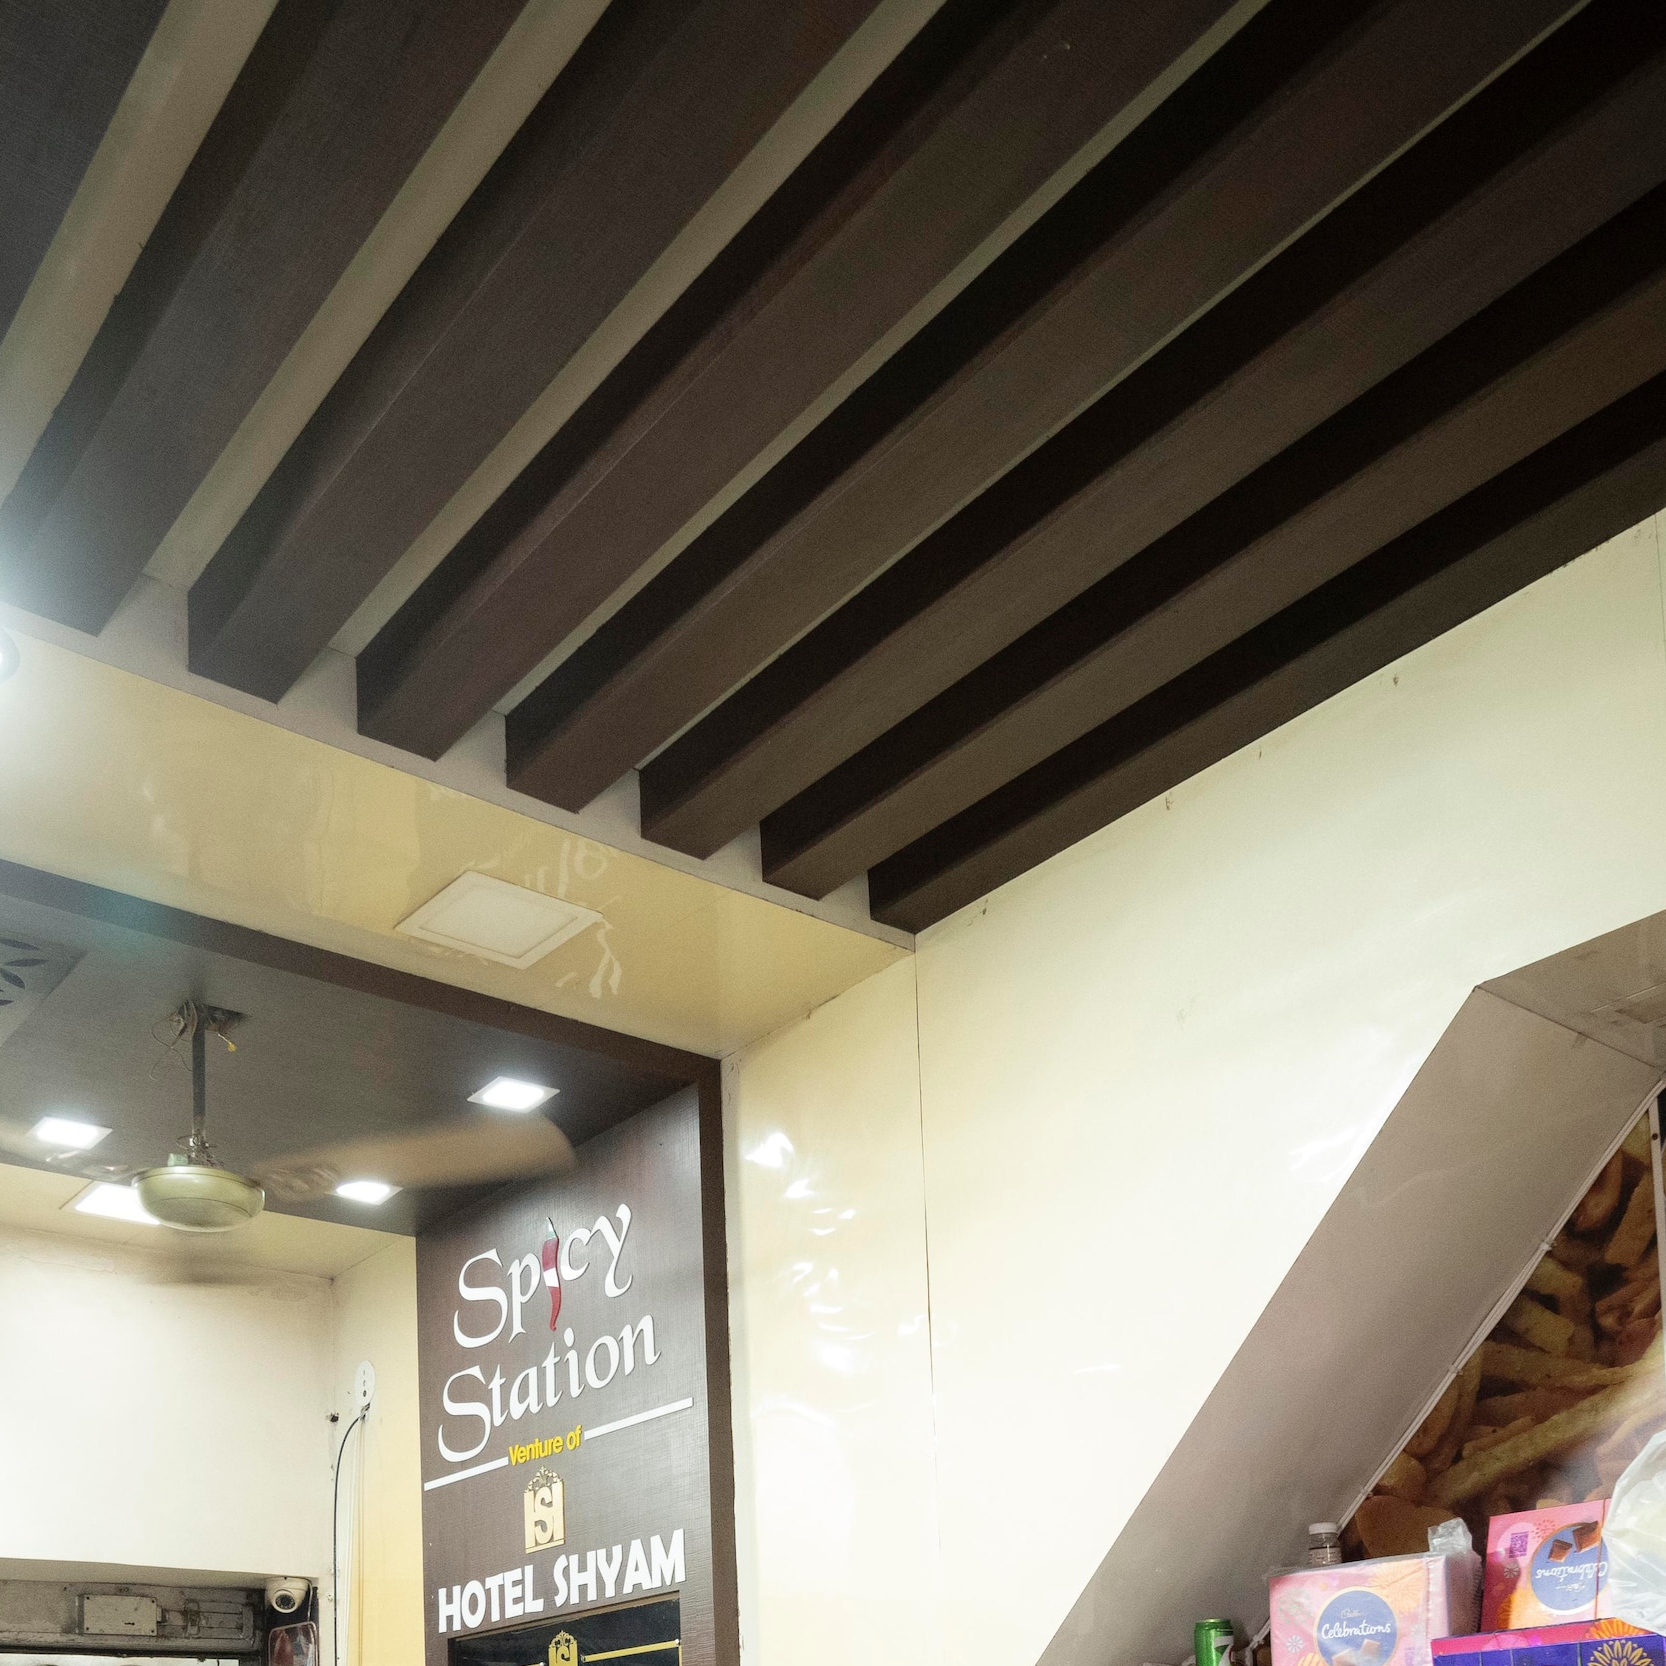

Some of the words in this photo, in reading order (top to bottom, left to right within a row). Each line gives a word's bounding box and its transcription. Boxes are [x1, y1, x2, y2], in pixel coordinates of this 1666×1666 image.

[454, 1204, 633, 1348] Spicy
[438, 1314, 662, 1462] Station
[509, 1431, 563, 1466] Venture
[566, 1425, 582, 1450] of
[438, 1565, 543, 1633] HOTEL
[554, 1528, 686, 1607] SHYAM
[1322, 1619, 1391, 1639] Celebrations
